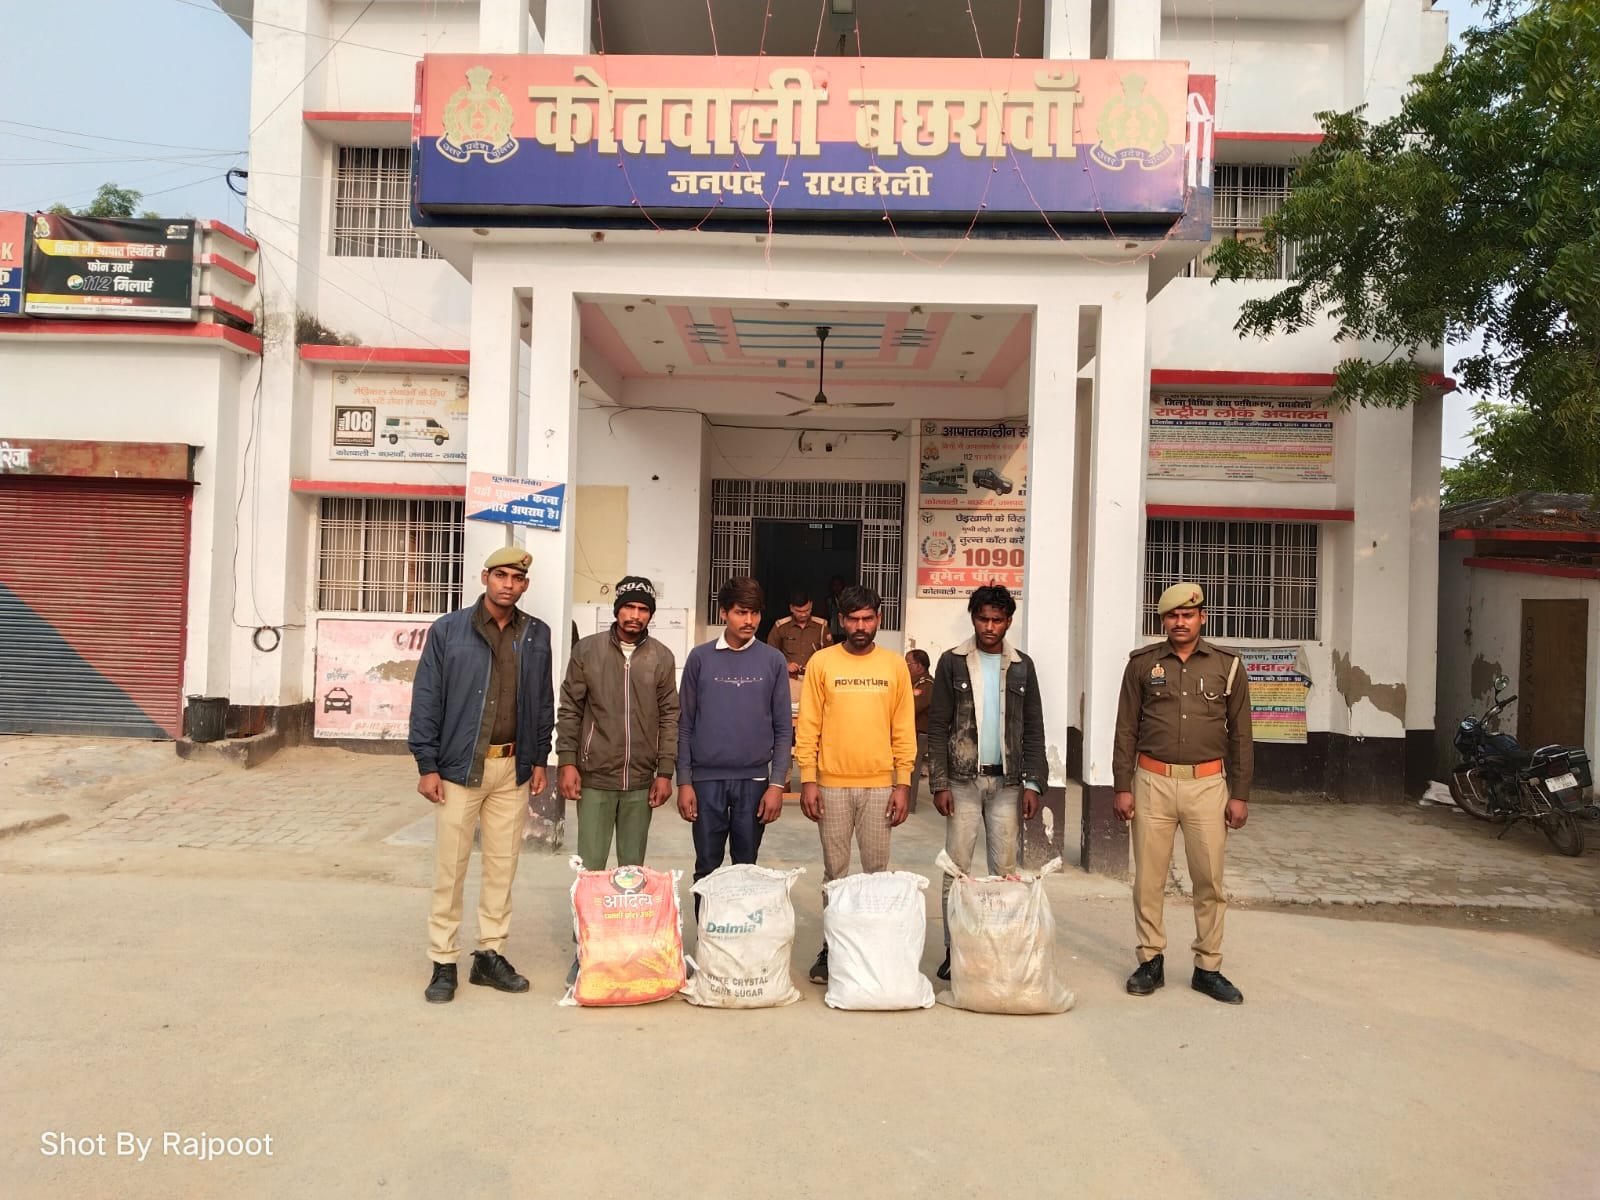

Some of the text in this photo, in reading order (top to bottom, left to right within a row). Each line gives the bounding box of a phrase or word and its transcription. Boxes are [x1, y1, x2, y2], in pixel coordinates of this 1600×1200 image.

[528, 66, 830, 156] कोतवाली
[667, 170, 765, 196] जनपद
[804, 166, 933, 197] रायबरेली
[96, 245, 125, 257] आपात
[126, 244, 155, 257] स्थिति
[155, 245, 168, 258] में
[87, 259, 134, 273] फोन उठाएं
[83, 275, 154, 292] 112 मिलाएं
[1216, 398, 1231, 407] सेवा
[1154, 406, 1329, 420] राष्ट्रीय लोक अदालत
[344, 411, 373, 432] 108
[942, 424, 1016, 438] आपातकालीन
[532, 493, 560, 506] करना
[995, 513, 1005, 523] के
[985, 535, 1007, 544] कॉल
[962, 547, 1025, 568] 1090
[923, 587, 956, 596] कोतवाली
[409, 628, 427, 650] 11
[834, 679, 889, 688] ADVENTURE
[706, 921, 757, 934] Dalmia
[732, 976, 769, 987] CRYSTAL
[734, 987, 764, 999] SUGAR
